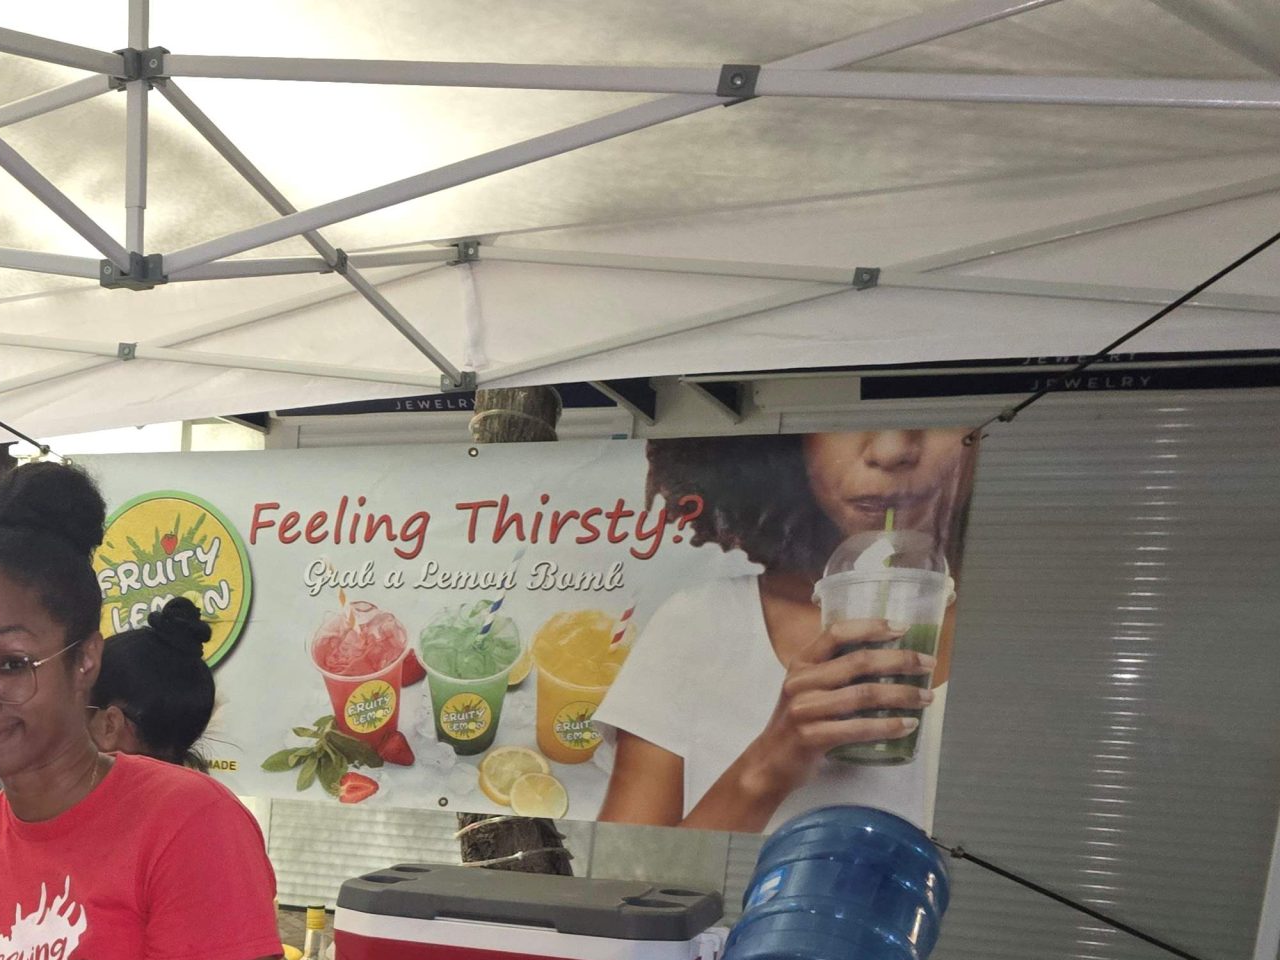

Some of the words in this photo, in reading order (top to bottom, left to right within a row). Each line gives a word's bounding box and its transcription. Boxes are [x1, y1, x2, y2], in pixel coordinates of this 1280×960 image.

[249, 494, 430, 560] Feeling
[456, 494, 704, 560] Thirsty?
[97, 537, 220, 598] FRUITY
[304, 560, 374, 596] Grab
[383, 569, 406, 590] a
[415, 560, 518, 592] Lemon
[526, 560, 625, 593] Bomb
[111, 579, 231, 634] LEN
[347, 694, 393, 718] FRUITY
[442, 707, 486, 722] FRUITY
